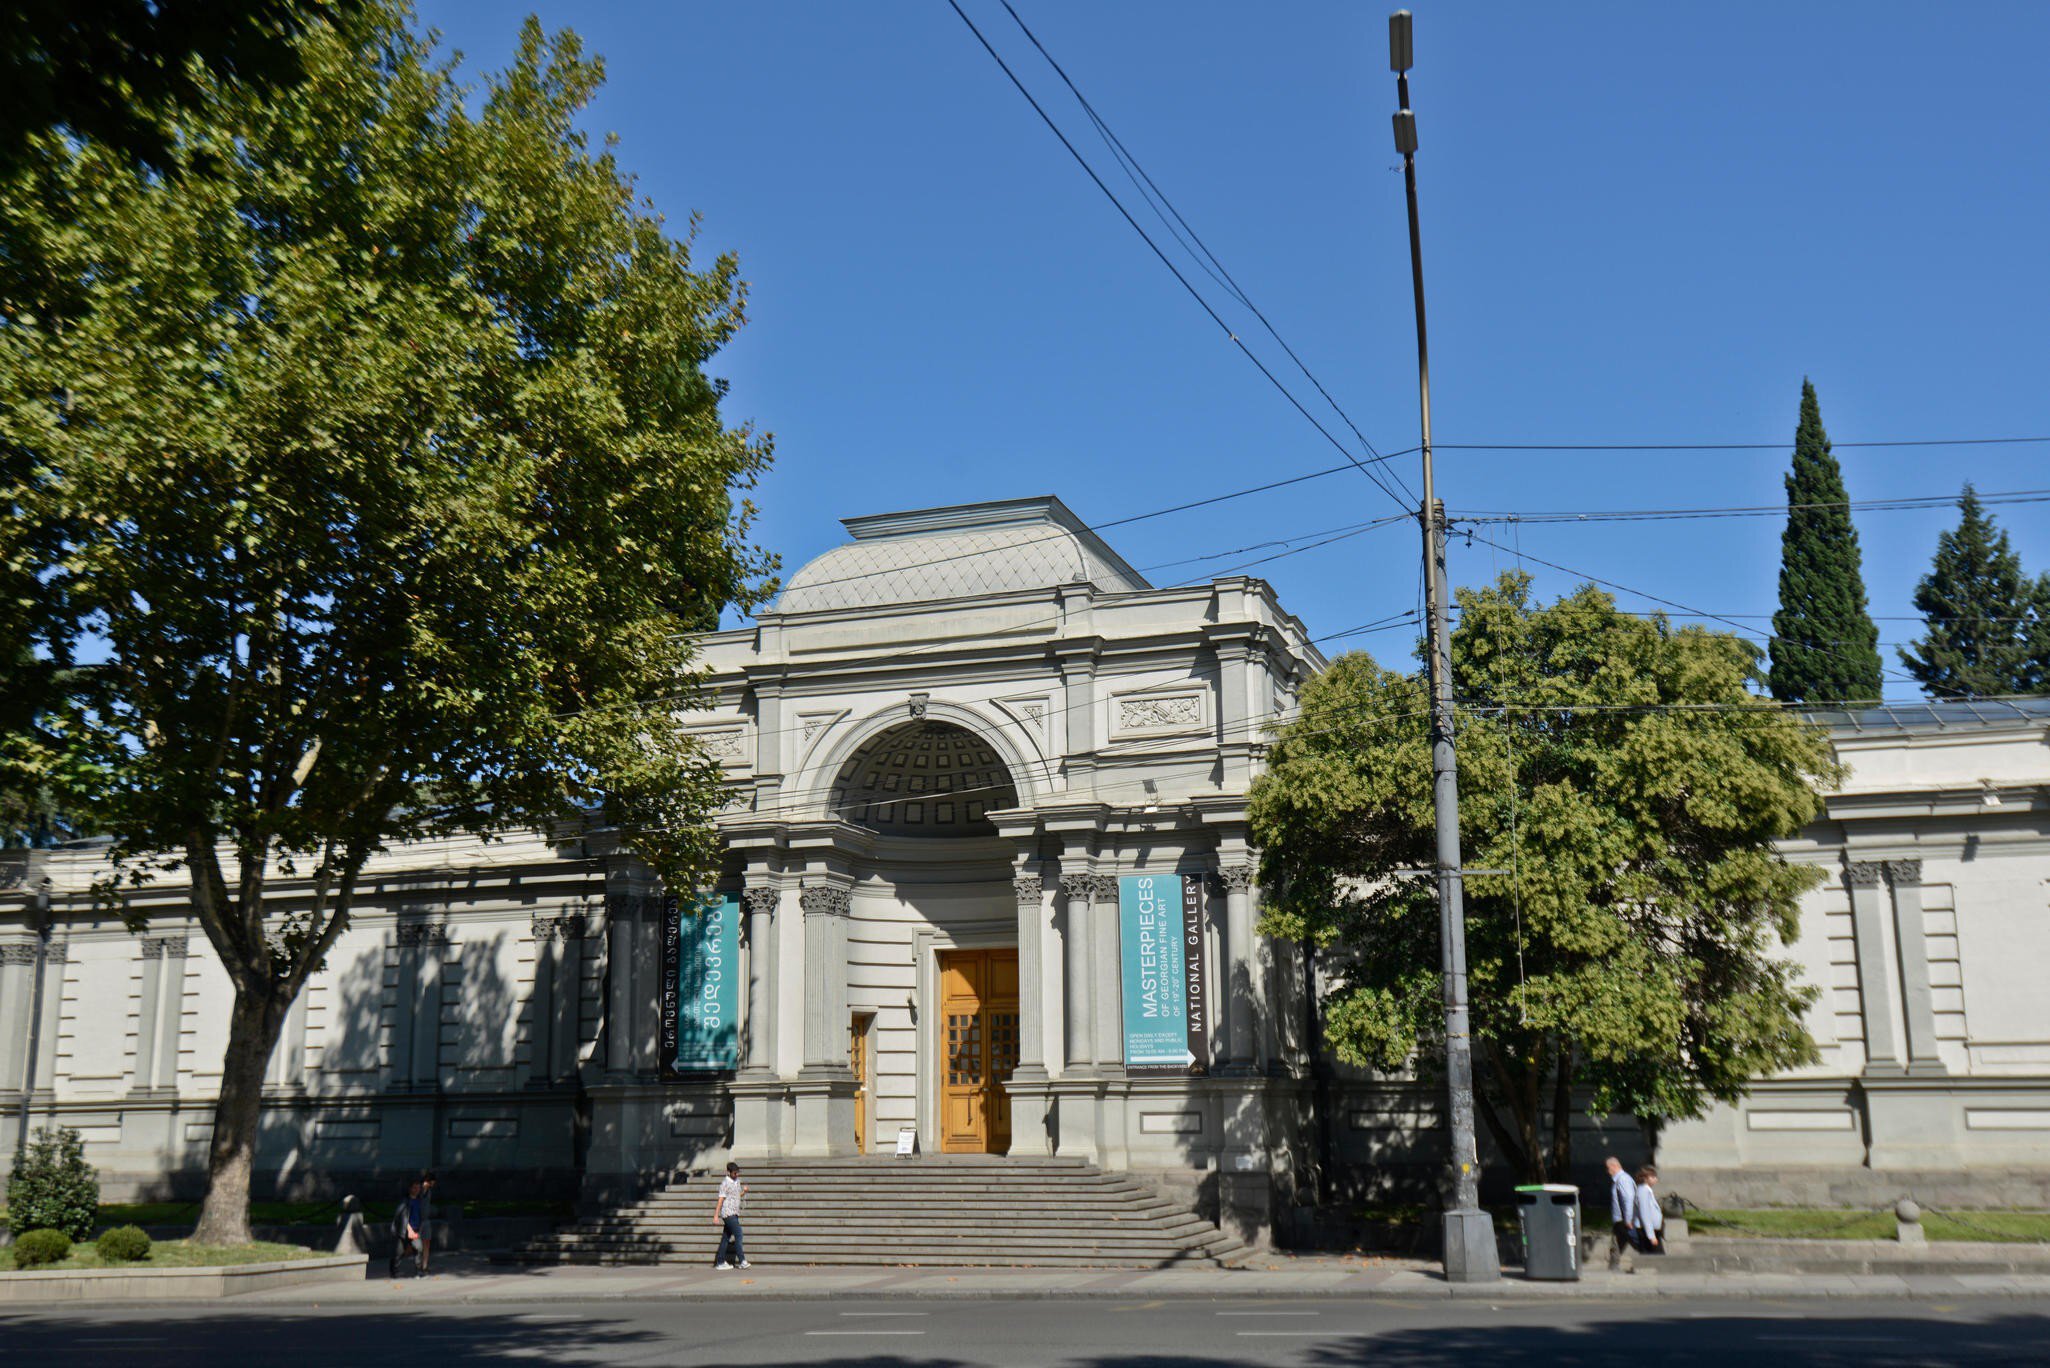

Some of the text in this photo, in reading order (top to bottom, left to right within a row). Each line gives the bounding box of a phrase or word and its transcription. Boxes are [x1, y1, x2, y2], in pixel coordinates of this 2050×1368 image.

[1138, 877, 1158, 1018] MASTERPIECES
[1157, 898, 1170, 1017] OF GEORGIAN FINE ART
[1171, 936, 1179, 974] CENTURY
[1185, 875, 1202, 1032] NATIONAL GALLERY
[664, 969, 676, 1048] ეროვნული
[1173, 1006, 1180, 1017] OF
